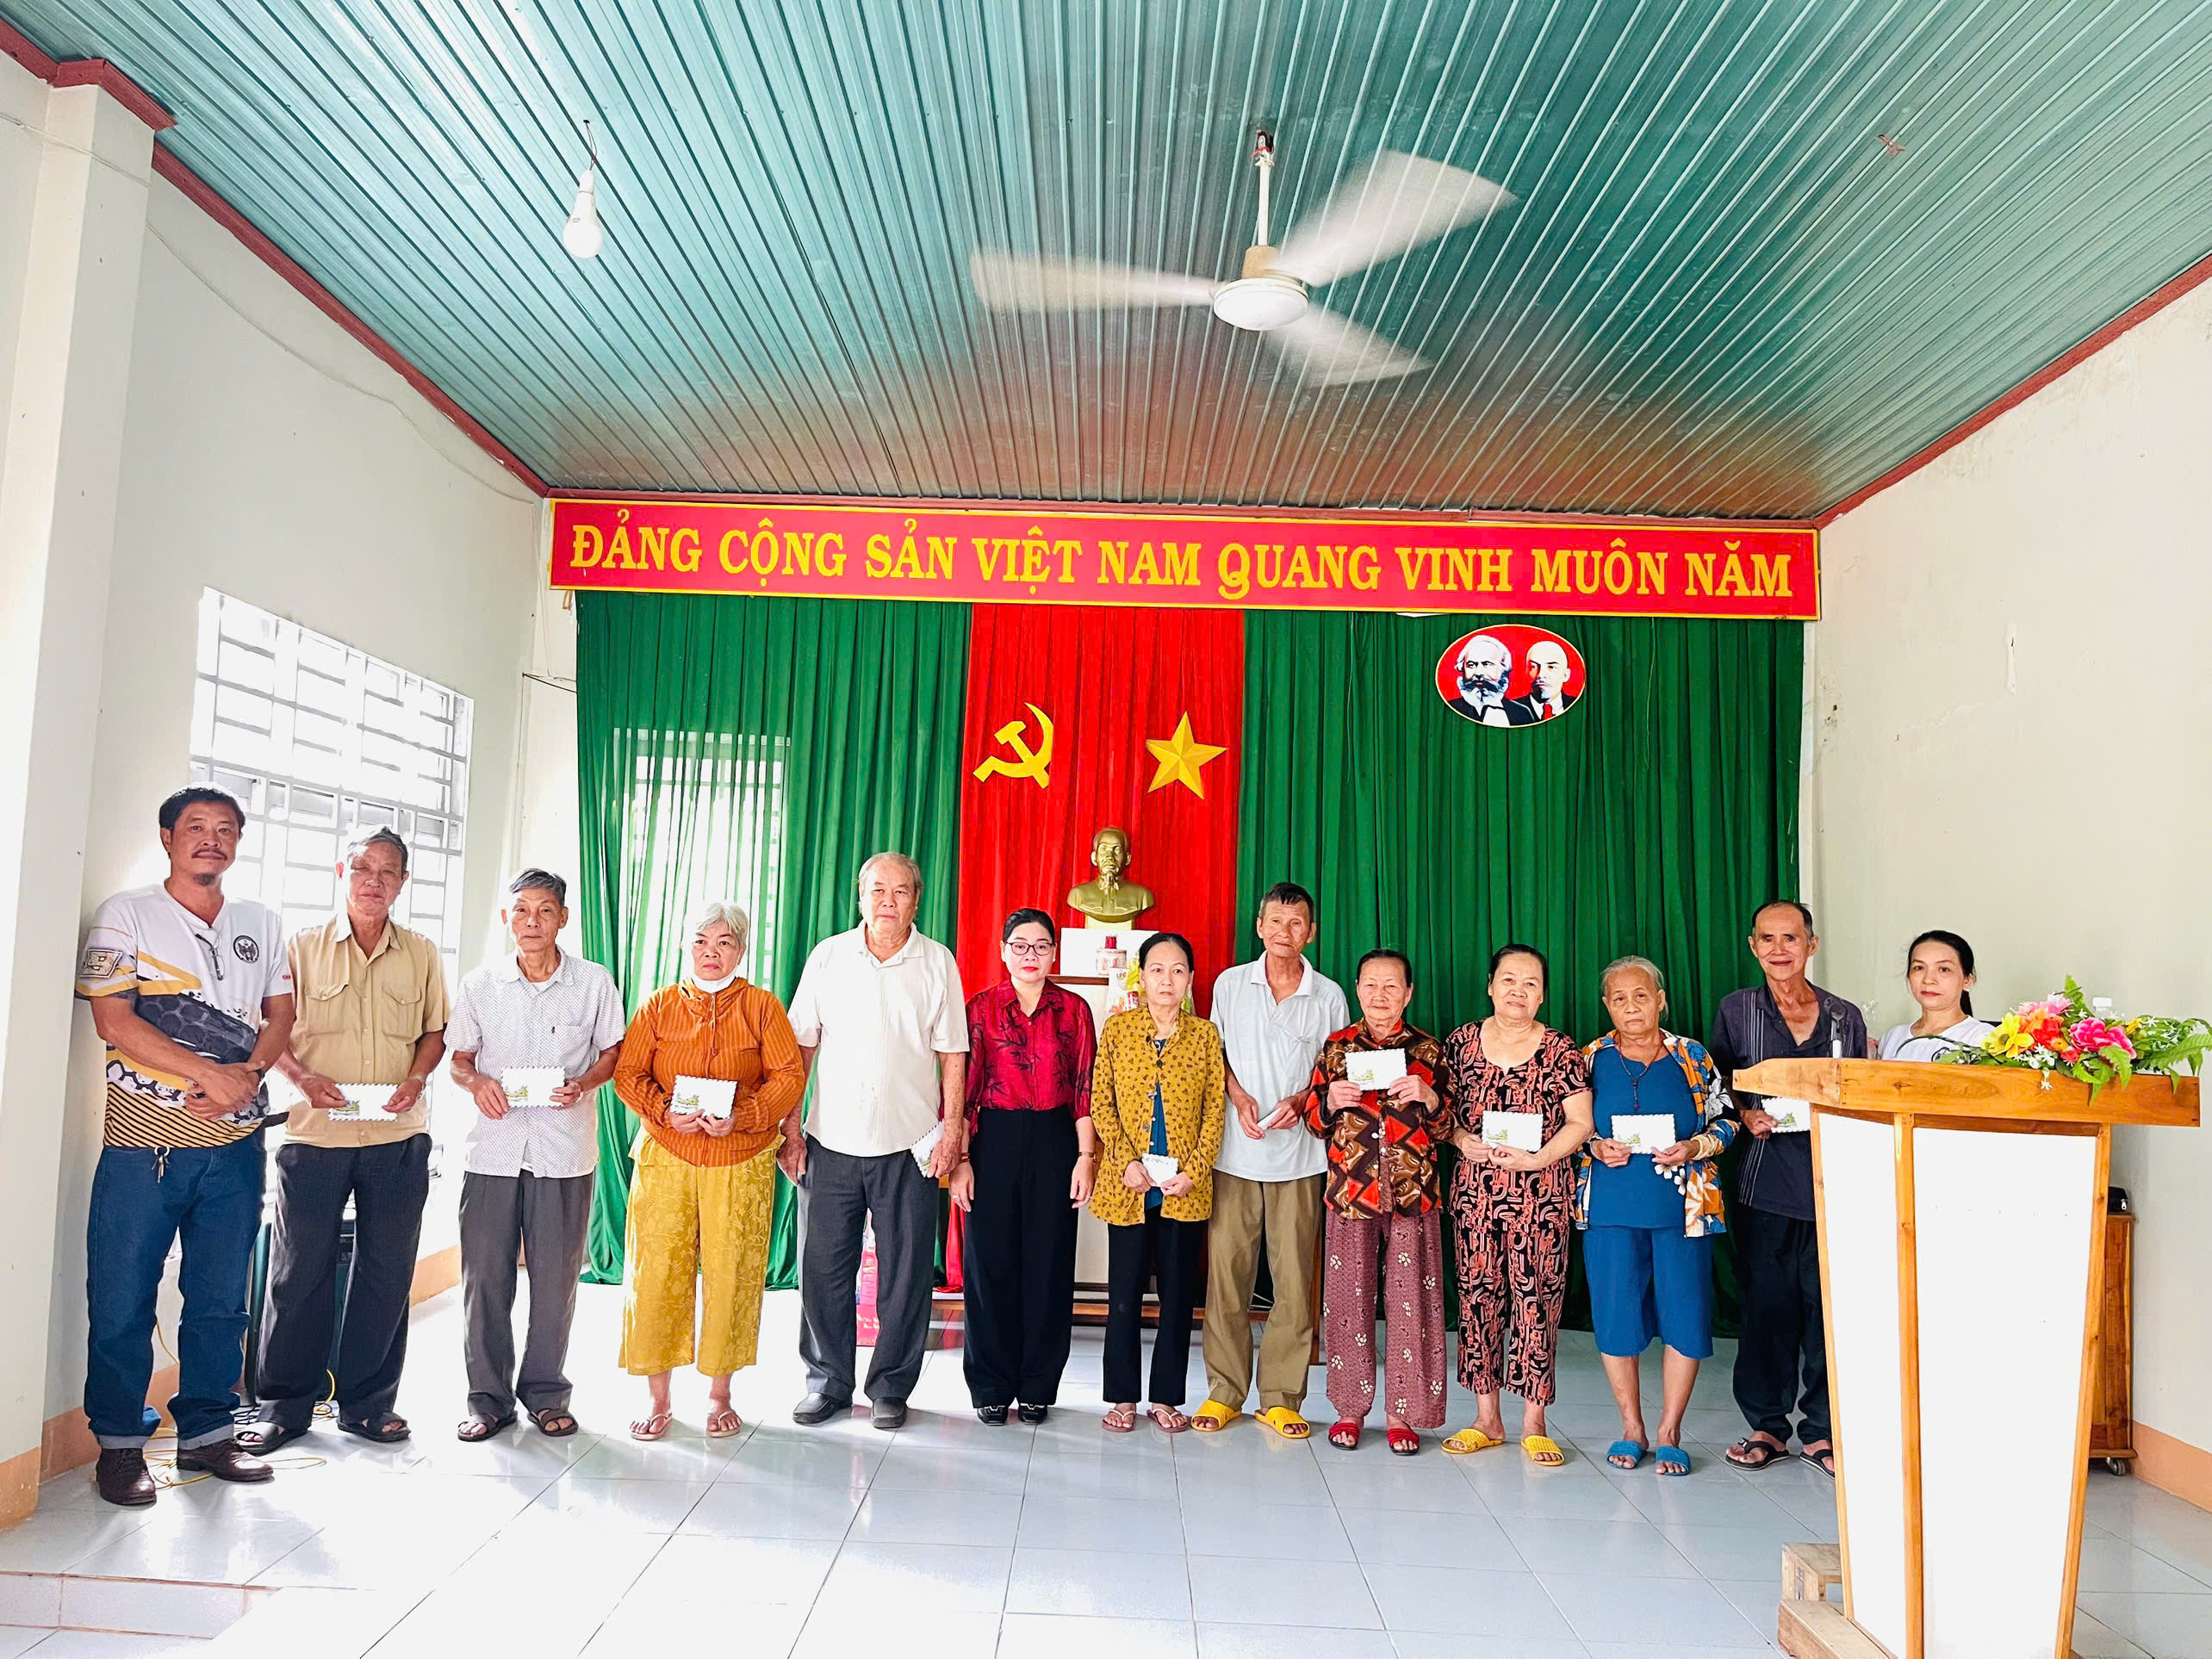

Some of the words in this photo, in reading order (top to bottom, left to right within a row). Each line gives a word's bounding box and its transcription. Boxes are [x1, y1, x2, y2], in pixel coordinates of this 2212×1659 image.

[569, 509, 704, 573] ĐẢNG
[718, 518, 848, 587] CỘNG
[865, 518, 959, 580] SẢN
[971, 525, 1083, 593] VIỆT
[1097, 540, 1202, 587] NAM
[1218, 543, 1382, 600] QUANG
[1395, 547, 1513, 593] VINH
[1531, 537, 1668, 596] MUÔN
[1684, 541, 1793, 597] NĂM
